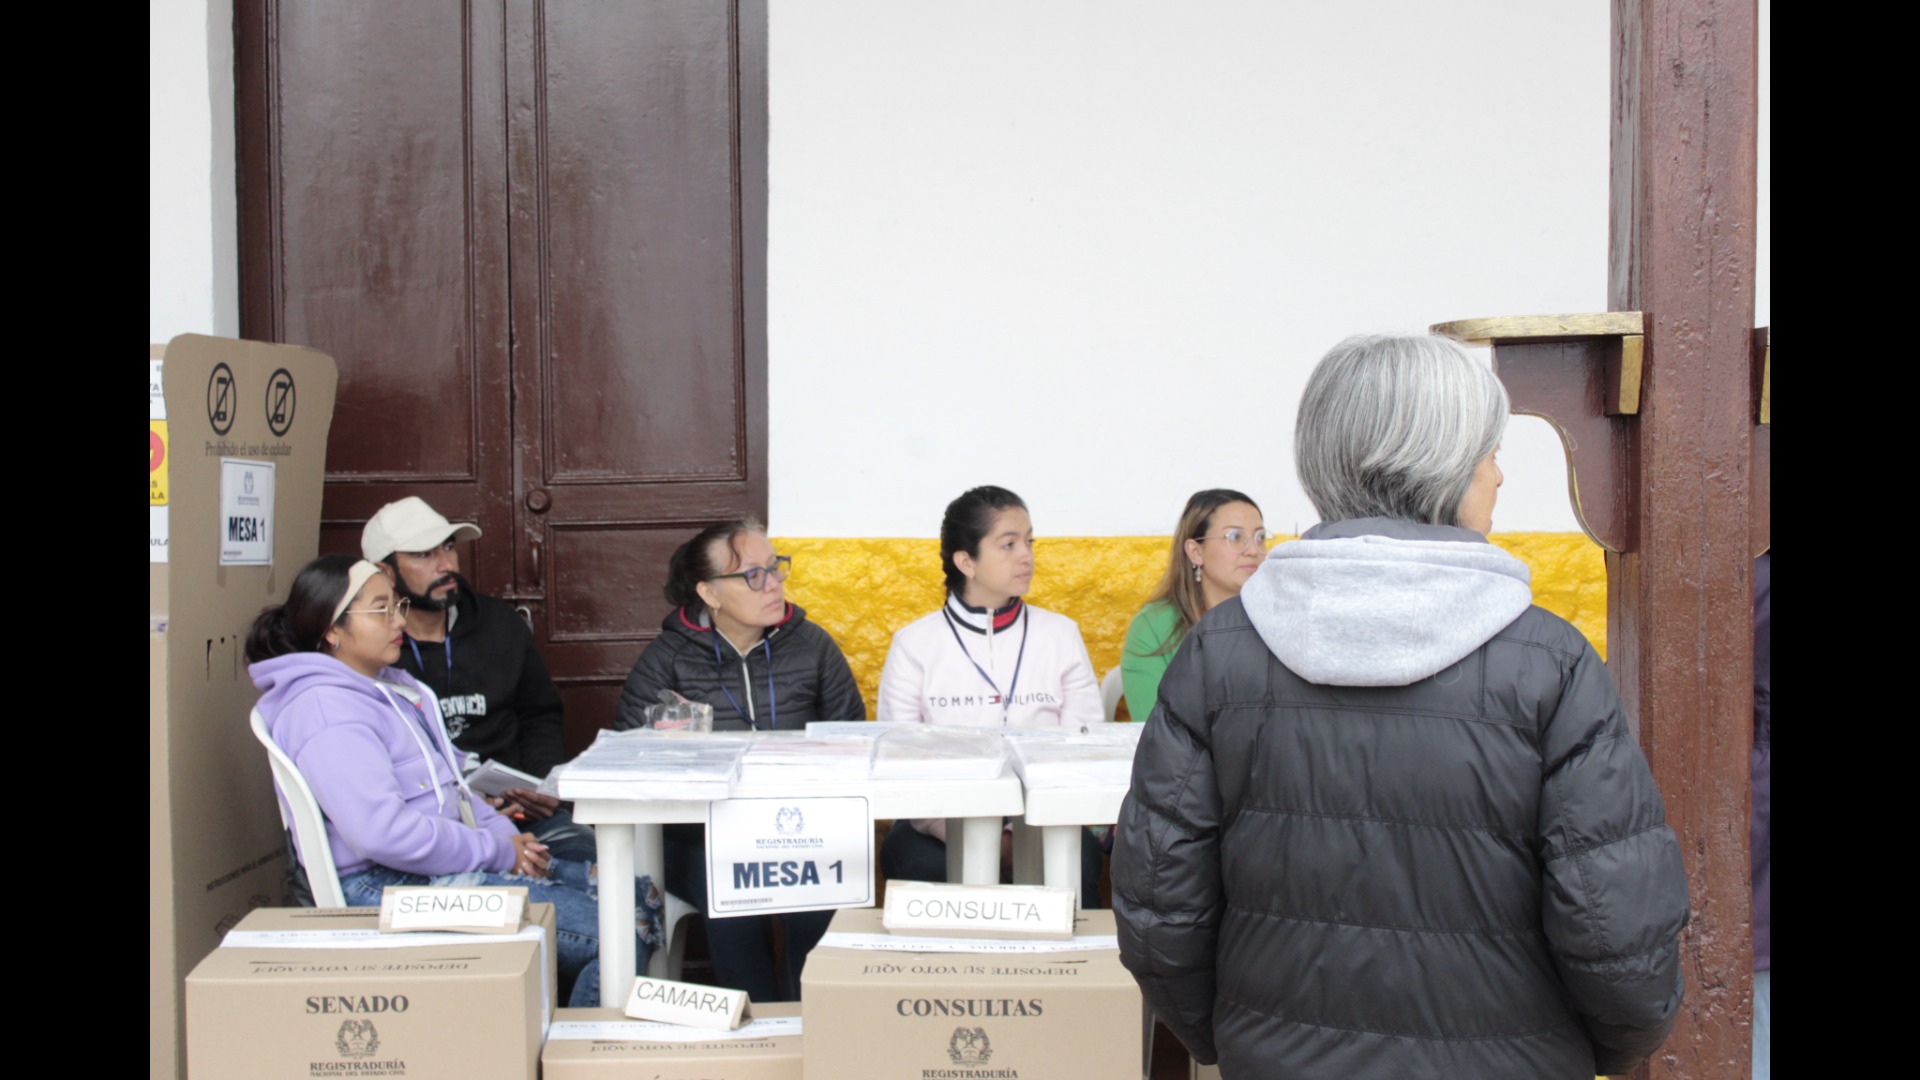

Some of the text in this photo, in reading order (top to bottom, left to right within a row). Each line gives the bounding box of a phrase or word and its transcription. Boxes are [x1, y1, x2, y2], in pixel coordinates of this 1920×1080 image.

[205, 441, 239, 456] Prohibido
[270, 441, 292, 456] celular
[229, 516, 266, 542] MESA 1
[929, 695, 984, 707] TOMMY
[756, 836, 823, 844] REGISTRADURÍA
[733, 860, 843, 889] MESA 1
[399, 894, 503, 913] SENADO
[906, 899, 1041, 921] CONSULTA
[384, 963, 469, 971] DEPOSITE
[863, 963, 1078, 976] DEPOSITE SU VOTO AQUÍ
[306, 995, 409, 1014] SENADO
[636, 981, 730, 1015] CAMARA
[896, 999, 1043, 1017] CONSULTAS
[310, 1058, 406, 1071] REGISTRADURÍA
[922, 1067, 1018, 1078] REGISTRADURÍA
